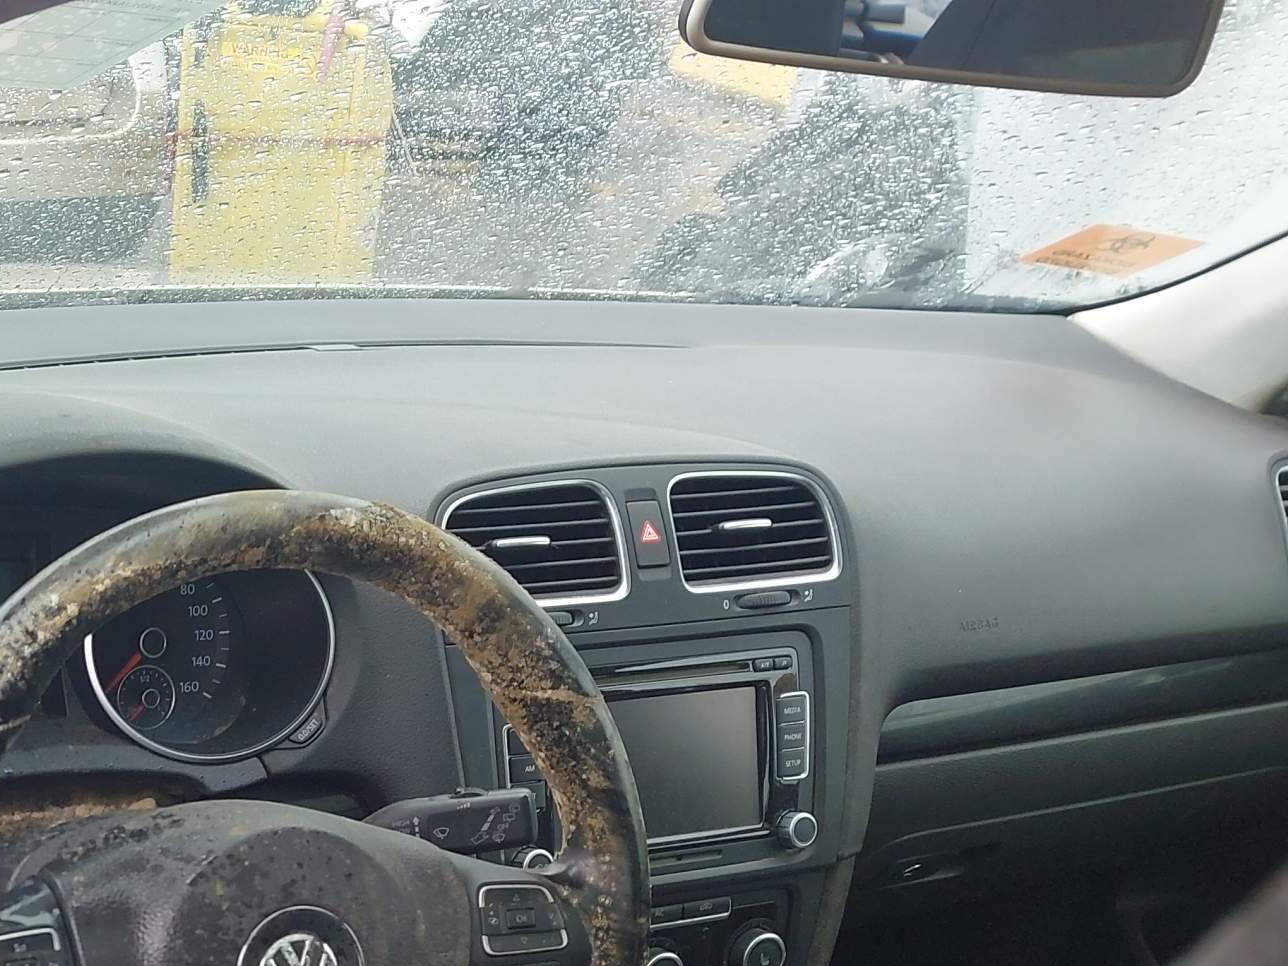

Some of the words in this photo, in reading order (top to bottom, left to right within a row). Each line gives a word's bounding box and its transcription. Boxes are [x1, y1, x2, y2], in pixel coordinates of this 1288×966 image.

[180, 584, 196, 596] 80
[723, 599, 730, 610] 0
[188, 605, 209, 617] 100
[194, 629, 214, 641] 120
[192, 656, 211, 668] 140
[179, 681, 200, 693] 160
[785, 759, 802, 767] SETUP
